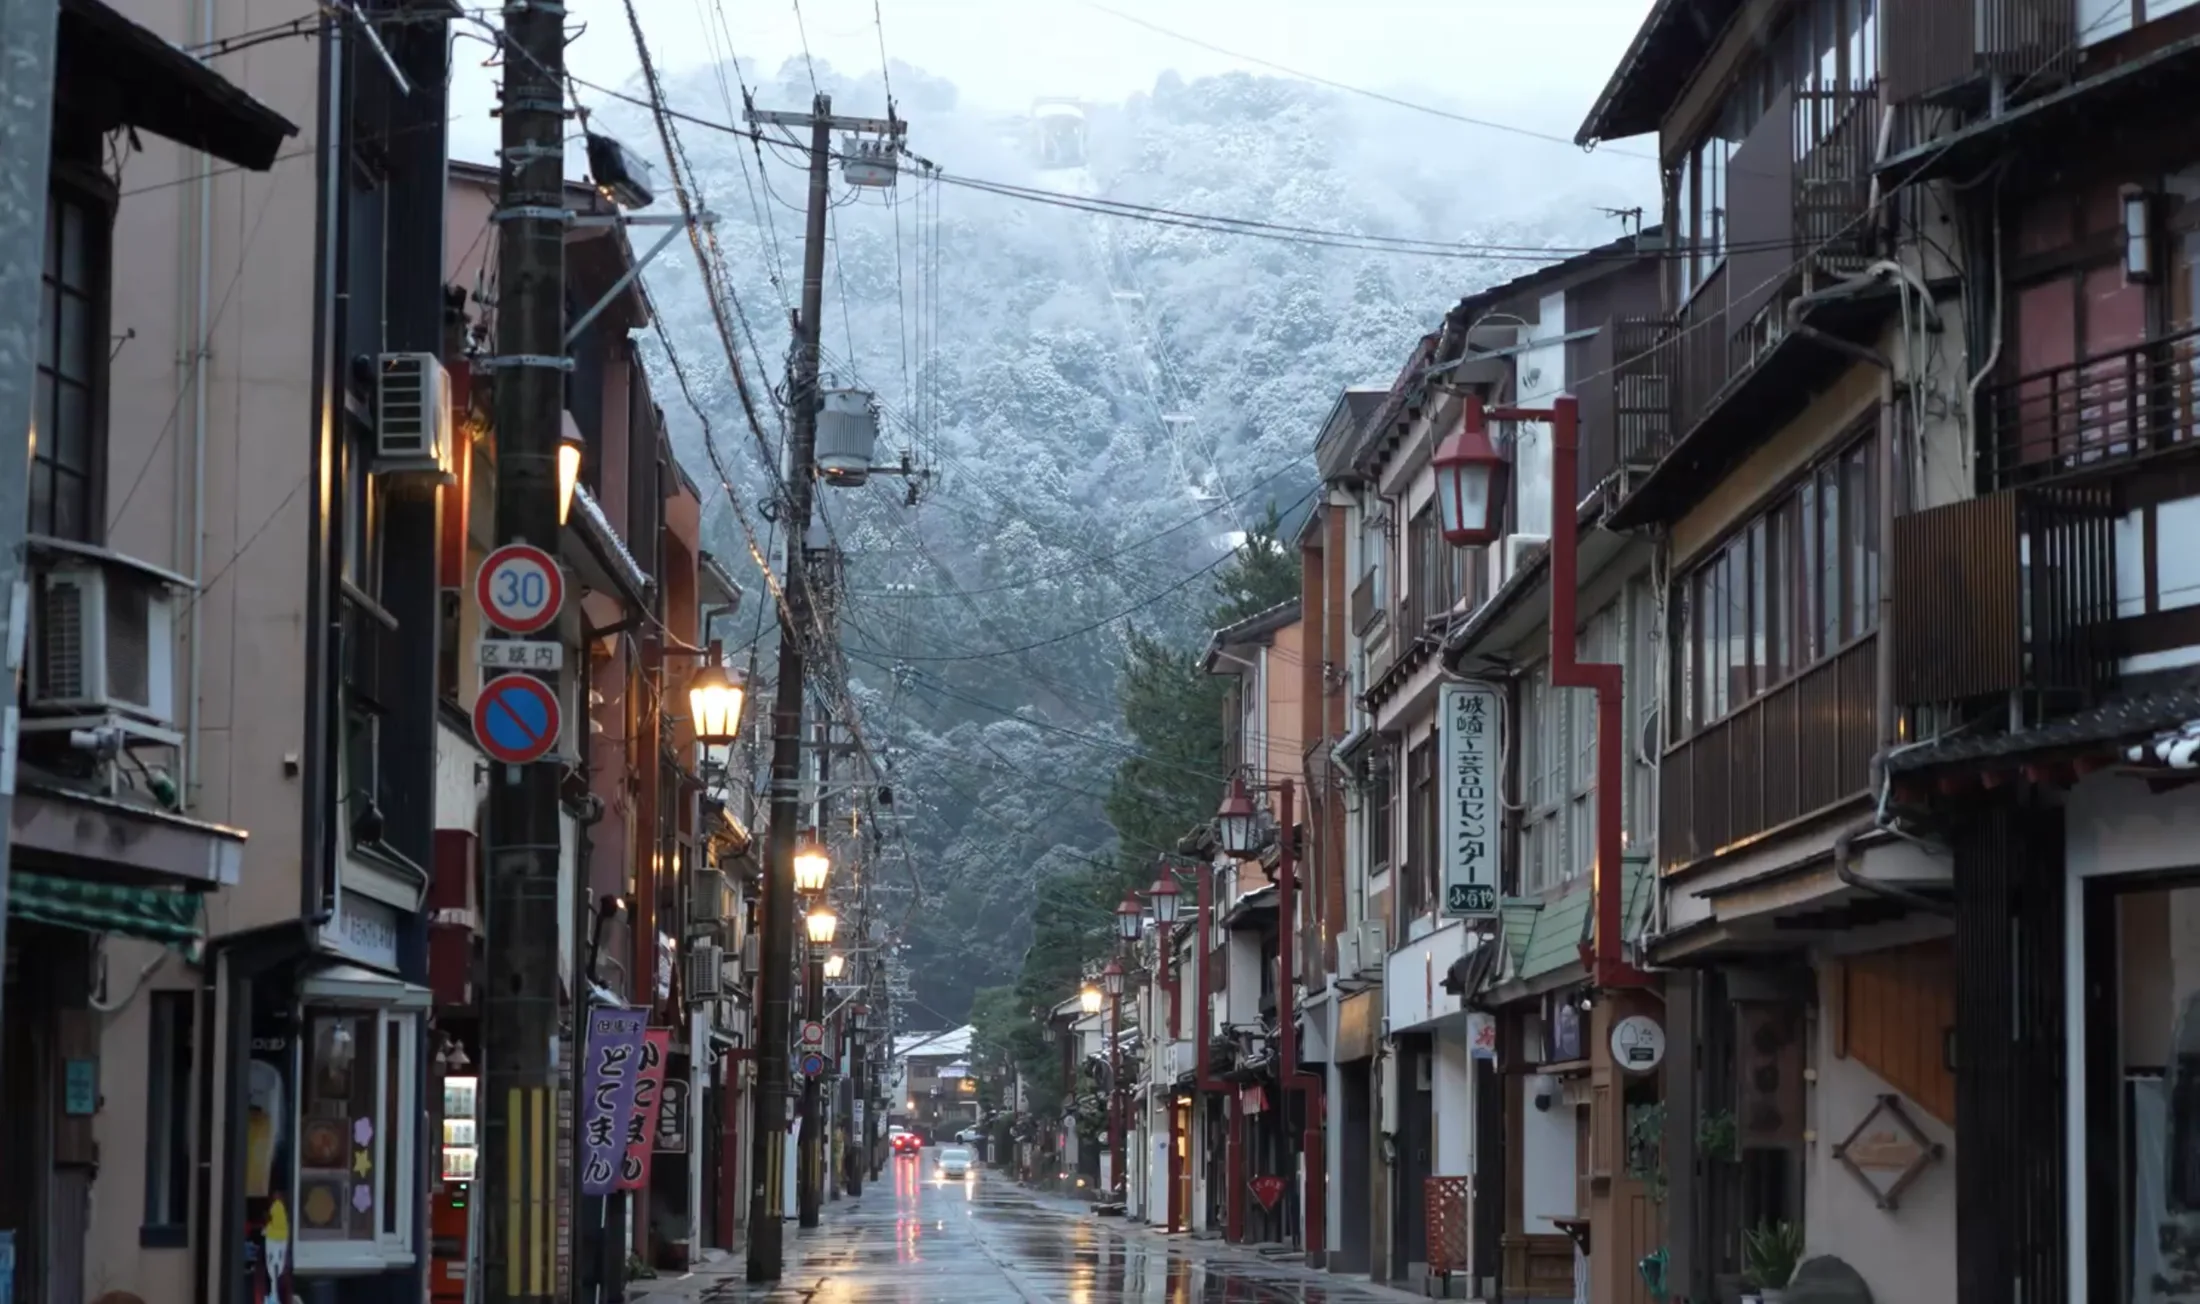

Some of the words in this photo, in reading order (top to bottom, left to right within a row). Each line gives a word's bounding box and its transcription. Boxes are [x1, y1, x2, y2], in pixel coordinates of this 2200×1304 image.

[498, 569, 544, 608] 30
[481, 644, 554, 666] 区域内
[1457, 695, 1487, 884] 城崎工芸品センター
[584, 1044, 632, 1182] どてまん
